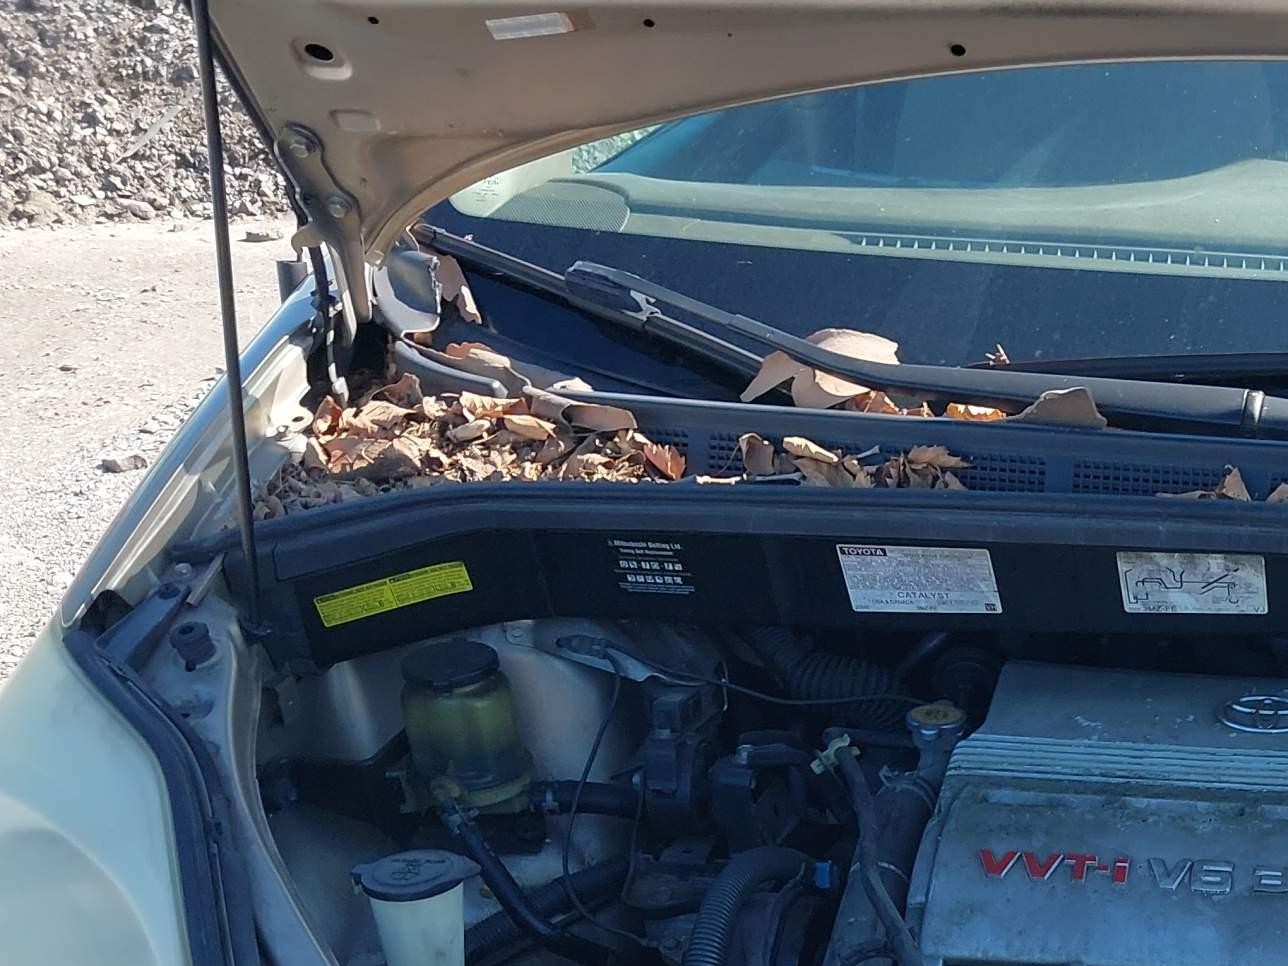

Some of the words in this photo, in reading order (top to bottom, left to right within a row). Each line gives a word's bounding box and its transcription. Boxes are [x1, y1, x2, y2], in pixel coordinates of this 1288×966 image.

[842, 547, 885, 556] TOYOTA
[897, 591, 951, 600] CATALYST
[979, 849, 1131, 885] VVT-i
[1149, 857, 1236, 896] V6
